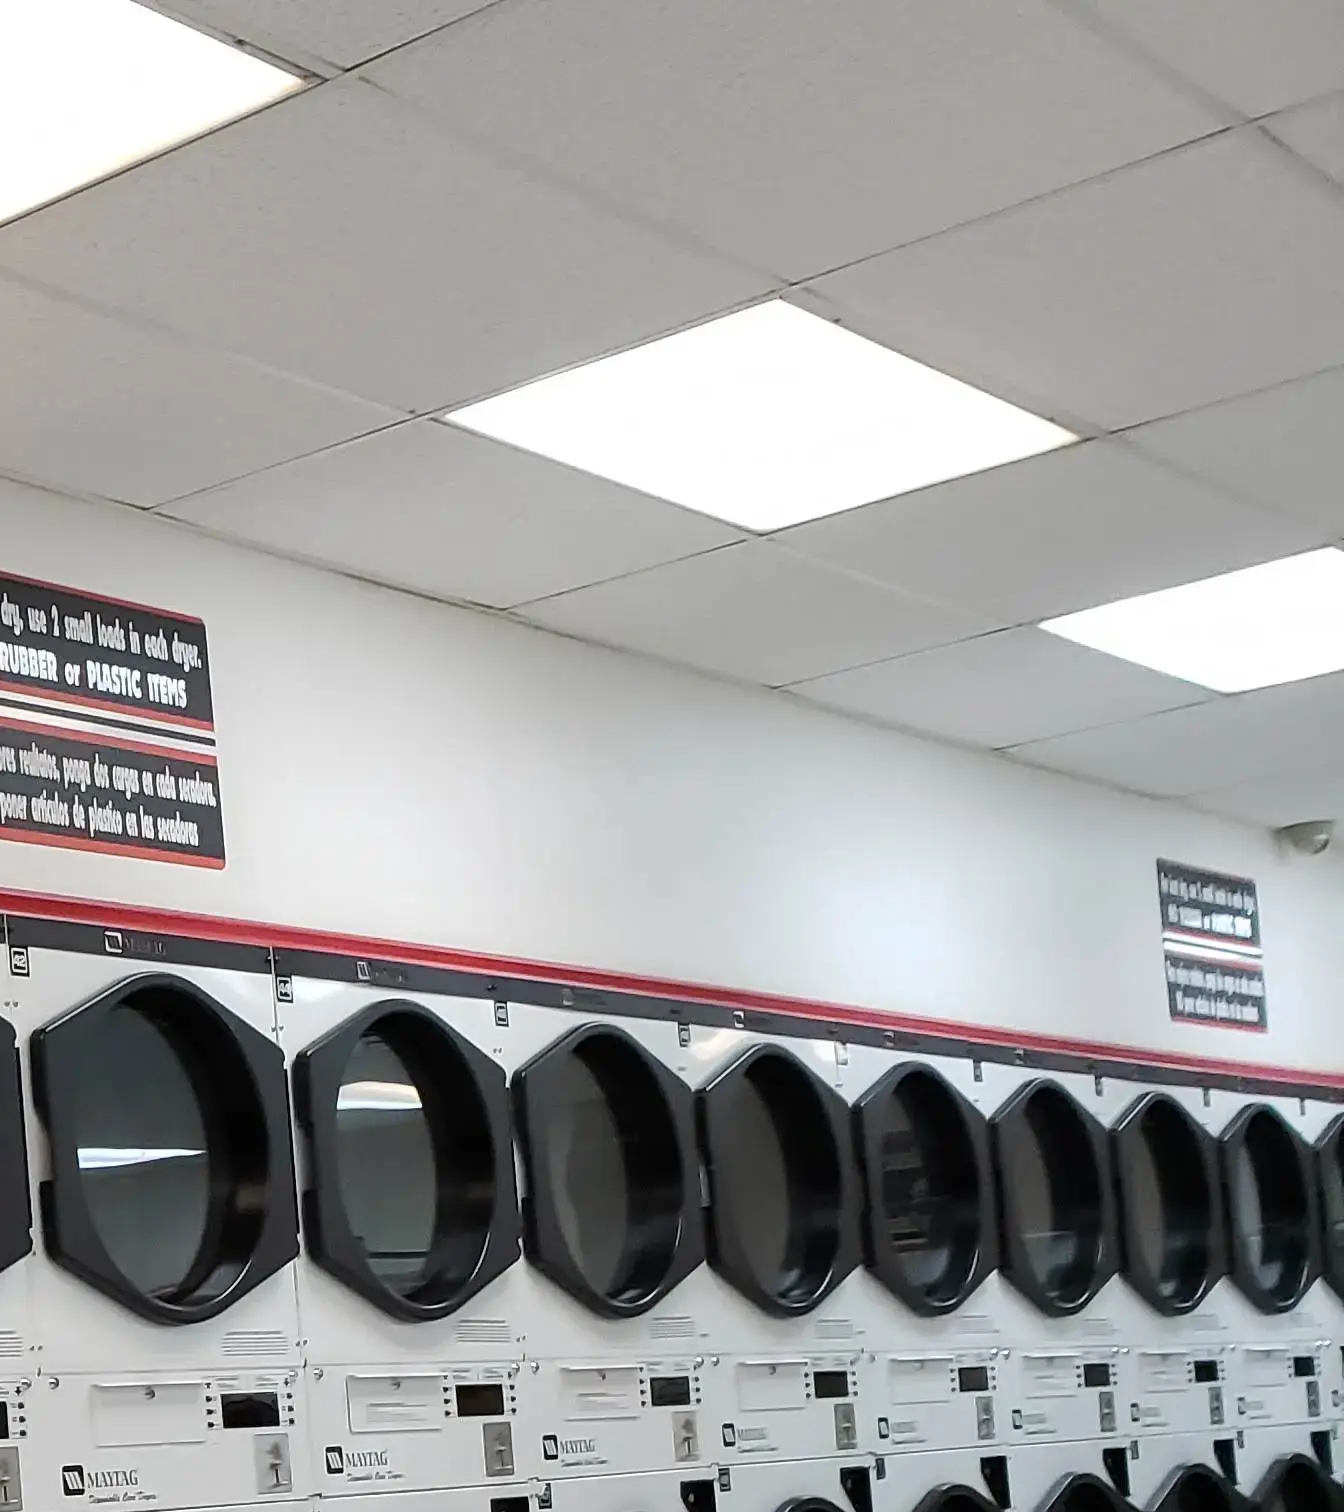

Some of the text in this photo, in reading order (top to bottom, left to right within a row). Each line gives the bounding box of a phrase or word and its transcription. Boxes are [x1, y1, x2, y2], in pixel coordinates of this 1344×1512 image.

[1, 593, 24, 636] dry,
[27, 607, 47, 634] use
[51, 604, 60, 637] 2
[64, 611, 93, 644] small
[96, 613, 126, 652] loads
[129, 621, 141, 654] in
[144, 628, 169, 661] each
[172, 632, 202, 672] dryer.
[64, 663, 80, 687] or
[86, 660, 143, 699] PLASTIC
[147, 672, 188, 709] ITEMS
[94, 753, 110, 789] dos
[142, 770, 154, 796] en
[0, 792, 28, 824] poner
[73, 794, 86, 829] de
[126, 811, 139, 837] en
[139, 805, 155, 840] las
[87, 1470, 139, 1489] MAYTAG
